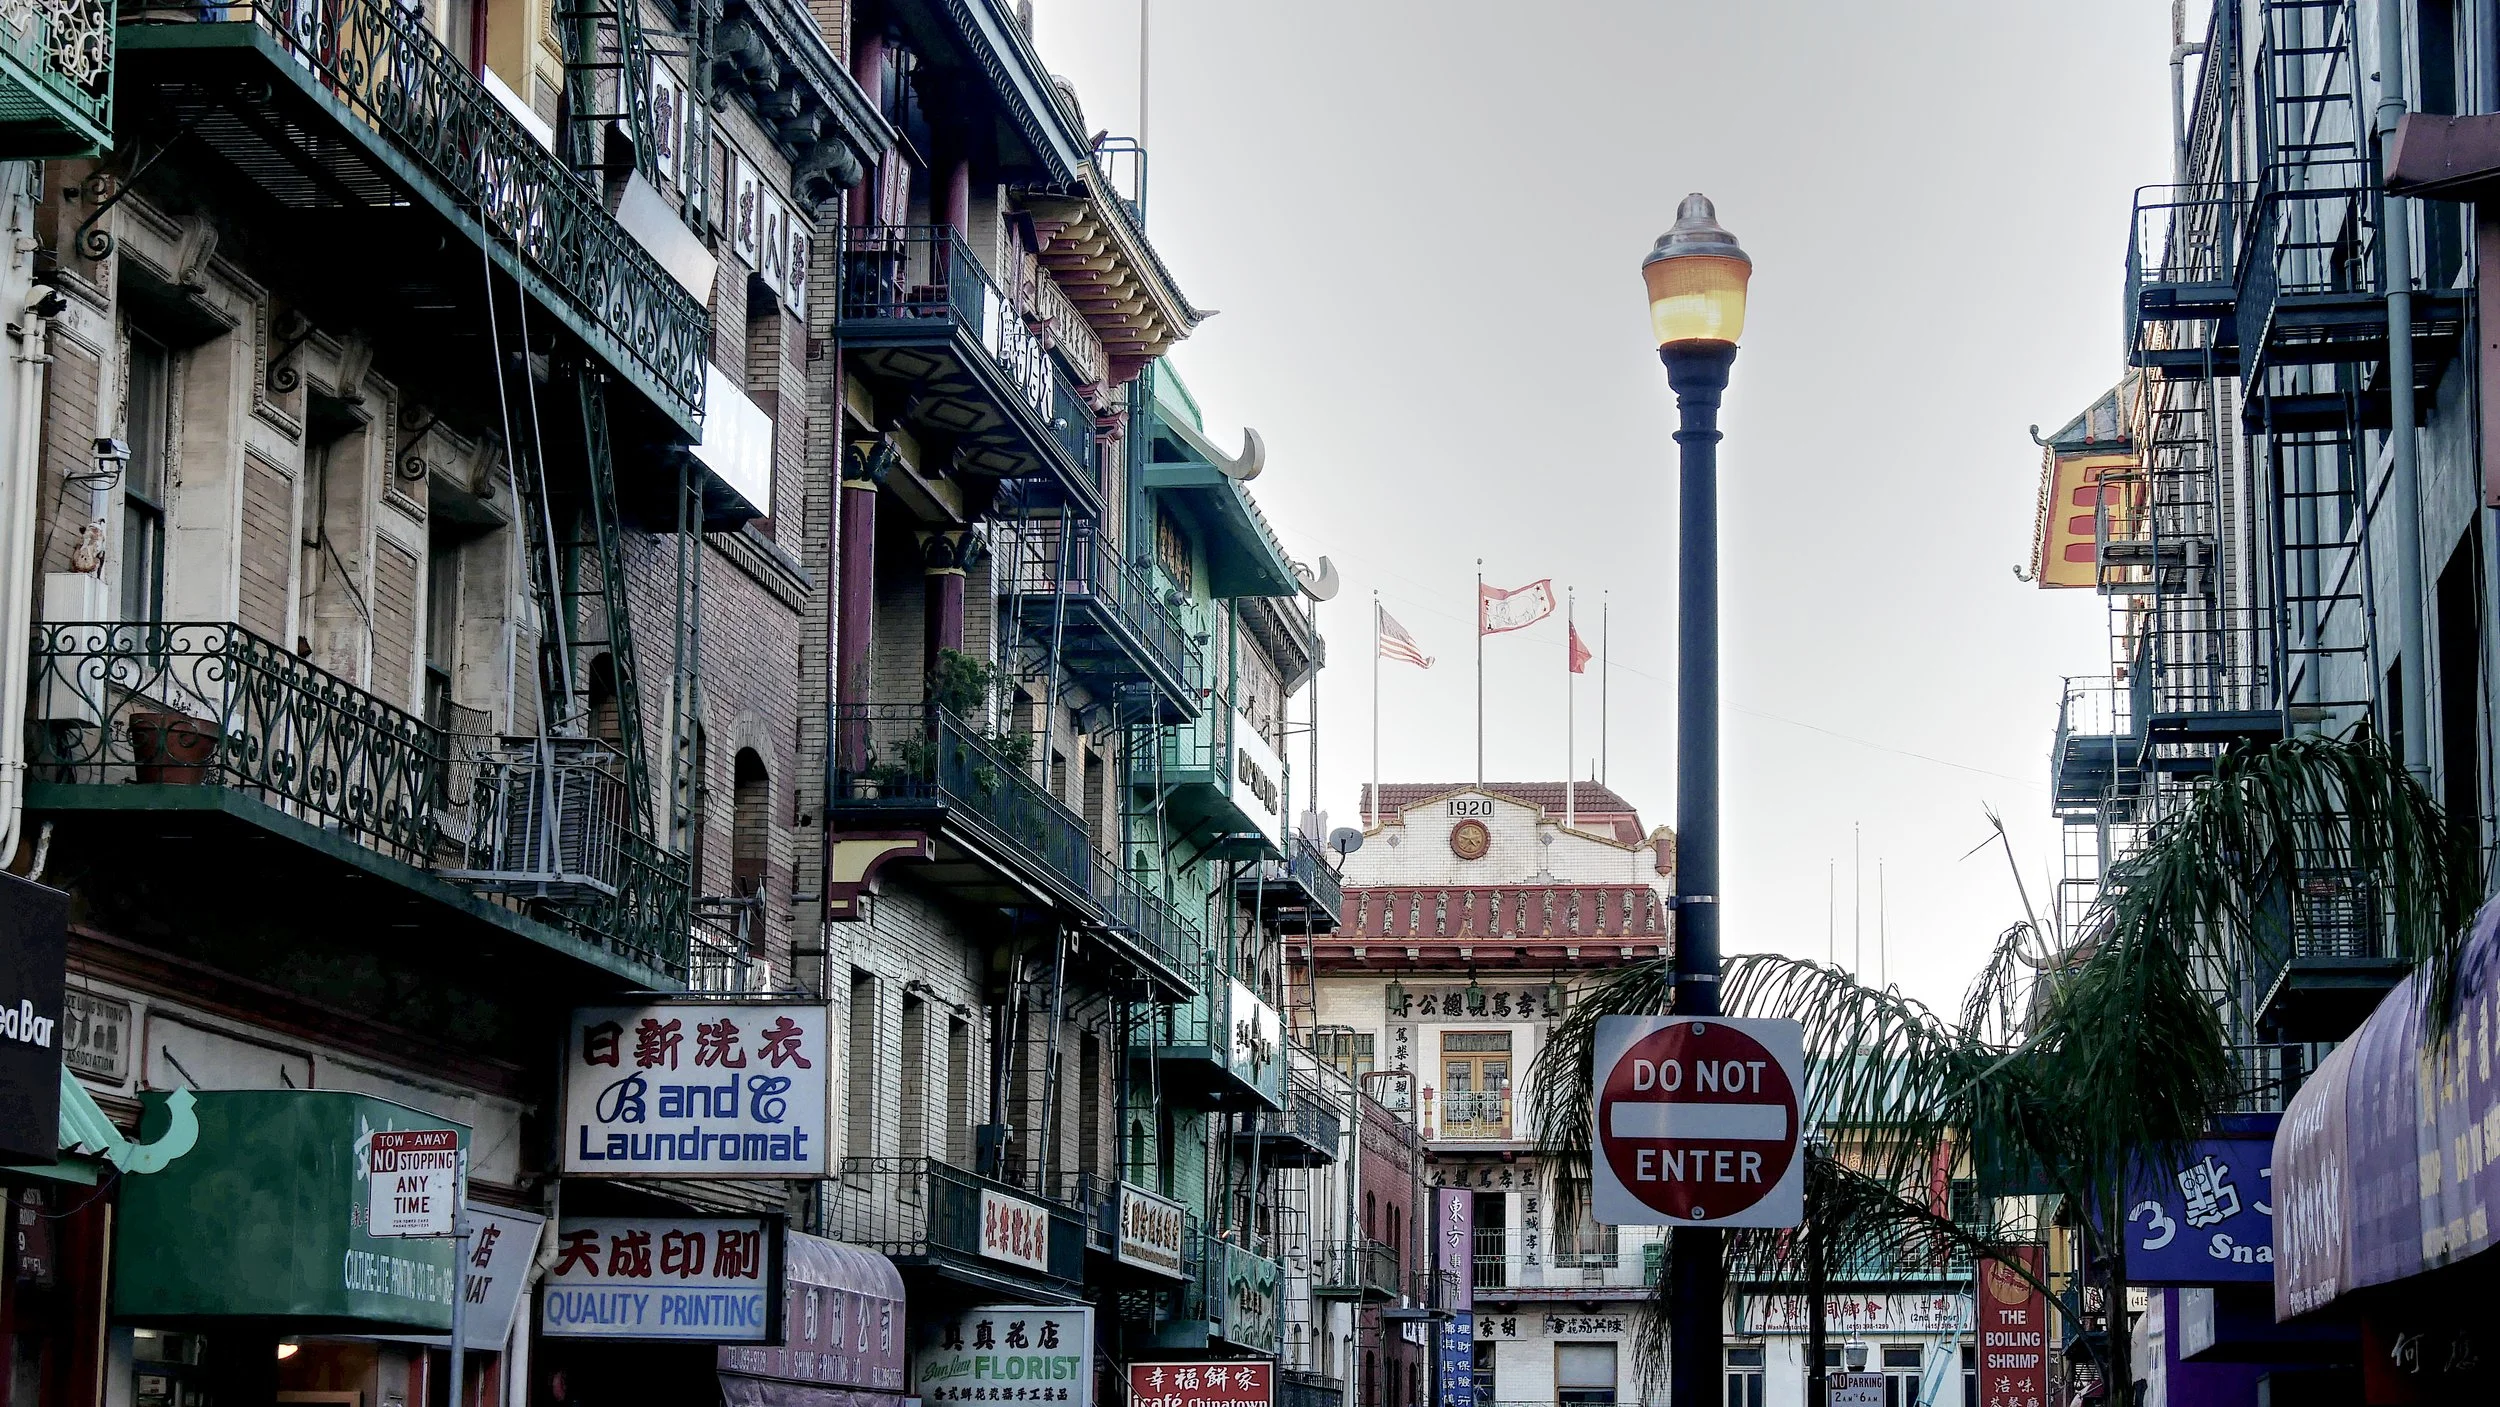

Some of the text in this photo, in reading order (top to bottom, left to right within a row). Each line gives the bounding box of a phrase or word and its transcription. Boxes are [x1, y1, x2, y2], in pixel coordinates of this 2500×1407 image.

[1449, 799, 1493, 816] 1920
[582, 1015, 812, 1070] 日新洗衣
[1633, 1059, 1766, 1094] DO NOT
[595, 1070, 791, 1124] B and C
[379, 1134, 403, 1148] TOW
[414, 1133, 449, 1146] AWAY
[579, 1125, 808, 1161] Laundromat
[374, 1149, 453, 1172] NO STOPPING
[1636, 1149, 1762, 1184] ENTER
[397, 1177, 428, 1193] ANY
[393, 1196, 431, 1214] TIME
[553, 1228, 761, 1280] 天成印刷
[546, 1291, 764, 1329] QUALITY PRINTING
[785, 1284, 893, 1358] 印刷公司
[1999, 1310, 2027, 1325] THE
[941, 1319, 1060, 1352] 真真花店
[1985, 1331, 2041, 1347] BOILING
[793, 1350, 815, 1379] SHING
[819, 1353, 849, 1382] PRINTING
[975, 1355, 1081, 1380] FLORIST
[1988, 1353, 2039, 1369] SHRIMP
[1145, 1366, 1261, 1393] 幸福餅家
[1831, 1374, 1882, 1388] NO PARKING
[1994, 1375, 2035, 1393] 浩味
[1835, 1392, 1841, 1402] 2
[1860, 1391, 1866, 1402] 6
